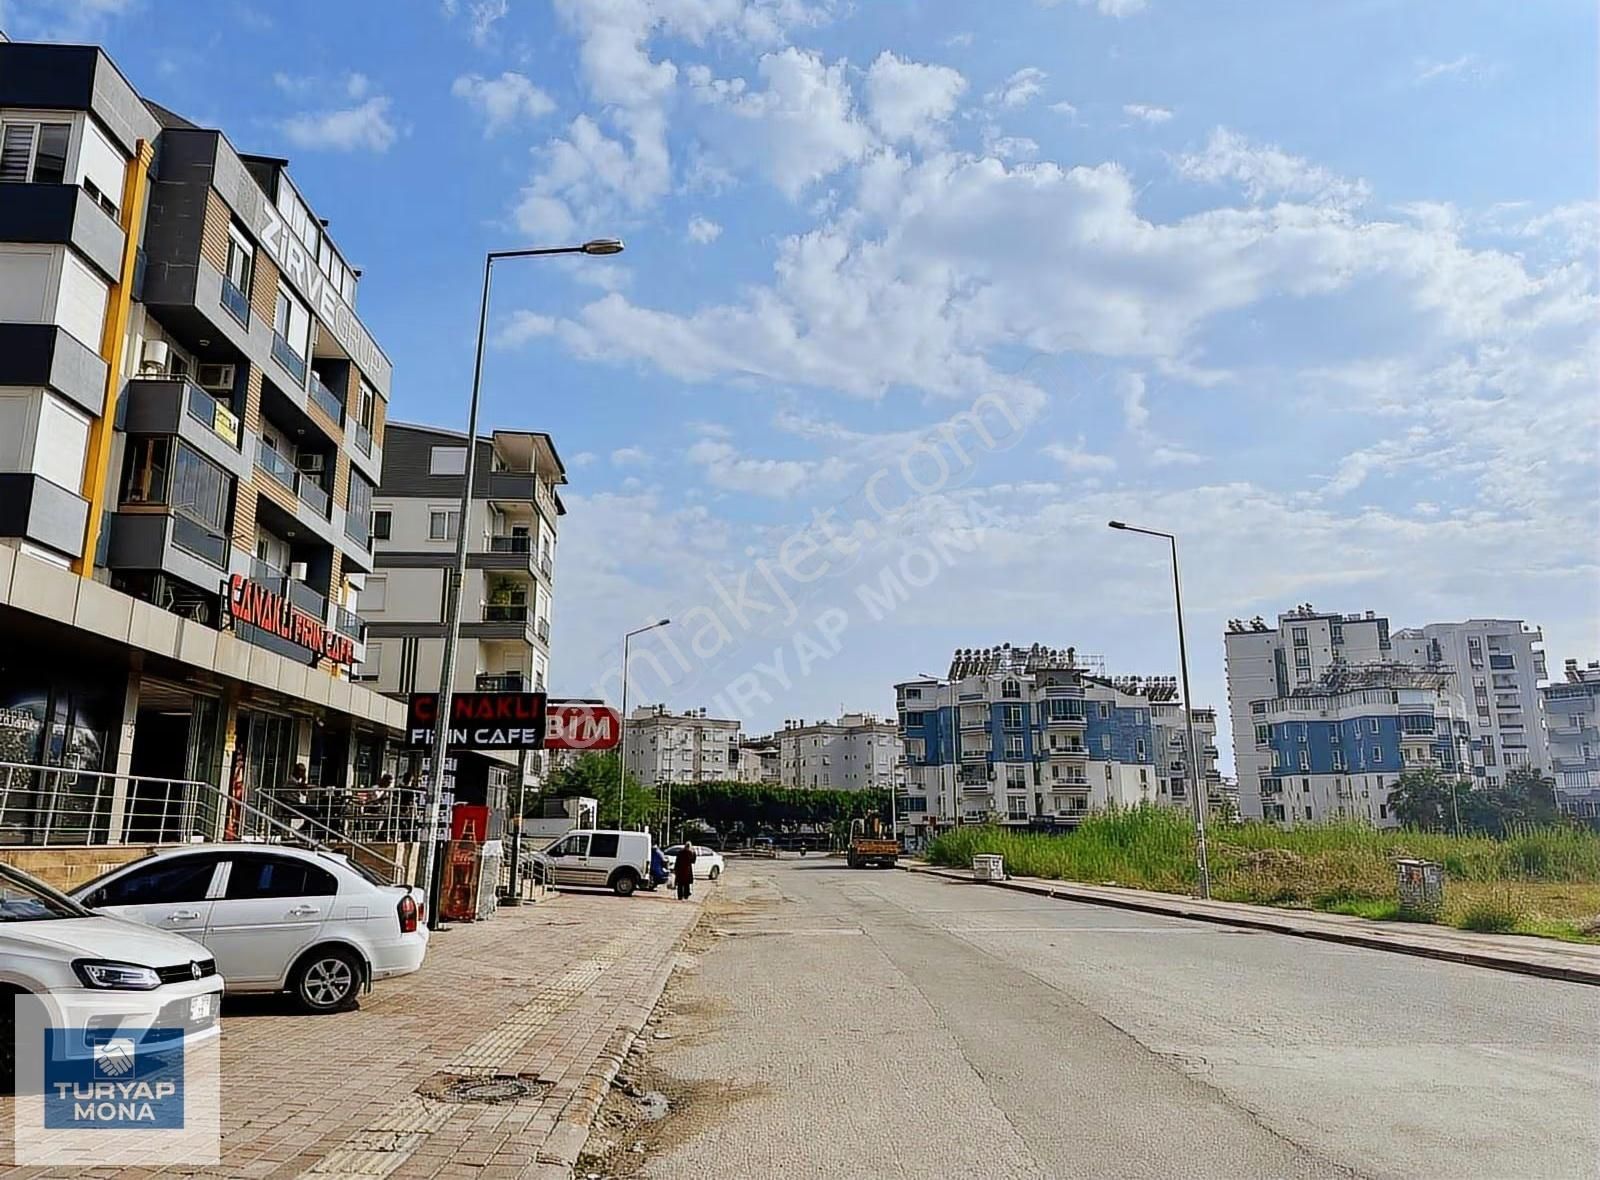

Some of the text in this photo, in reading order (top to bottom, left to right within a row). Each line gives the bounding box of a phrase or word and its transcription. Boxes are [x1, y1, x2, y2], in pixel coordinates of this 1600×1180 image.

[335, 304, 383, 378] GRUP
[415, 696, 539, 720] CNAKLI
[474, 728, 536, 744] CAFE
